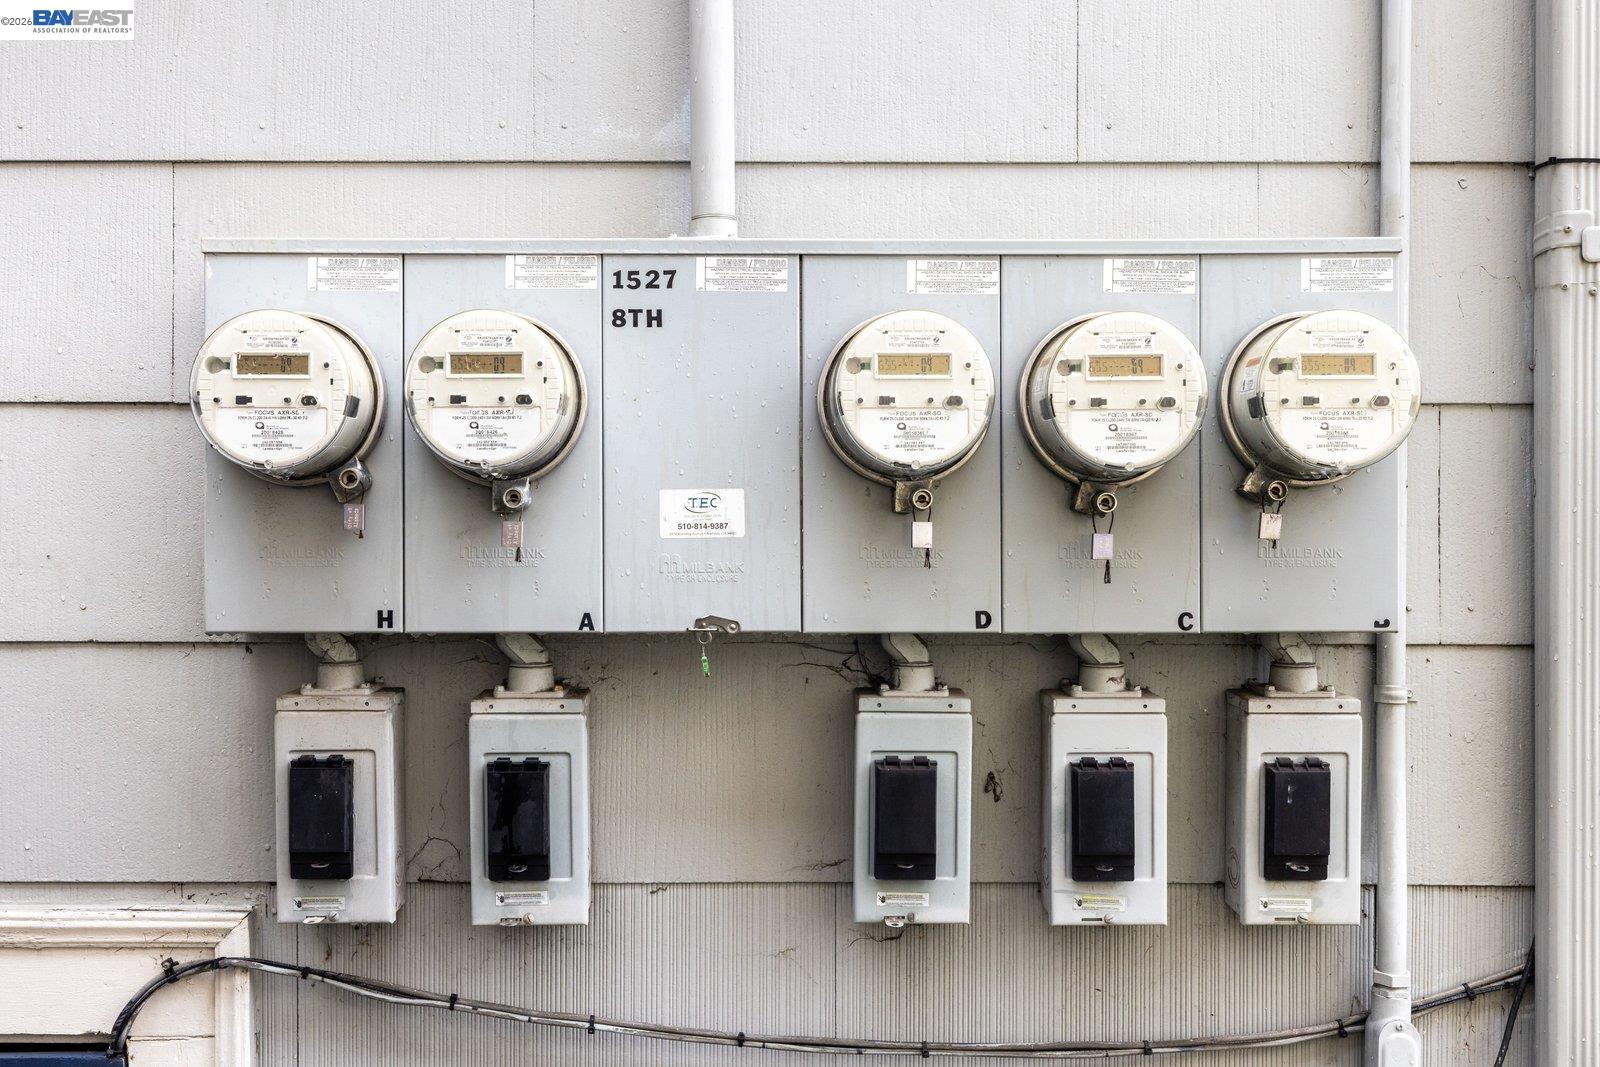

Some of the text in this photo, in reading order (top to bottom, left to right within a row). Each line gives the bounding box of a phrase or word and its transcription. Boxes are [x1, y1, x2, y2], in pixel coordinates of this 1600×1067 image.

[612, 269, 677, 290] 1527
[611, 308, 663, 328] 8TH
[688, 497, 717, 509] TEC
[482, 547, 545, 559] MILBANK
[1082, 548, 1143, 559] MANK
[1282, 548, 1343, 558] MILBANK
[683, 561, 744, 574] MILBANK
[377, 610, 393, 628] H
[578, 612, 594, 630] A
[975, 610, 992, 629] D
[1178, 612, 1194, 631] C
